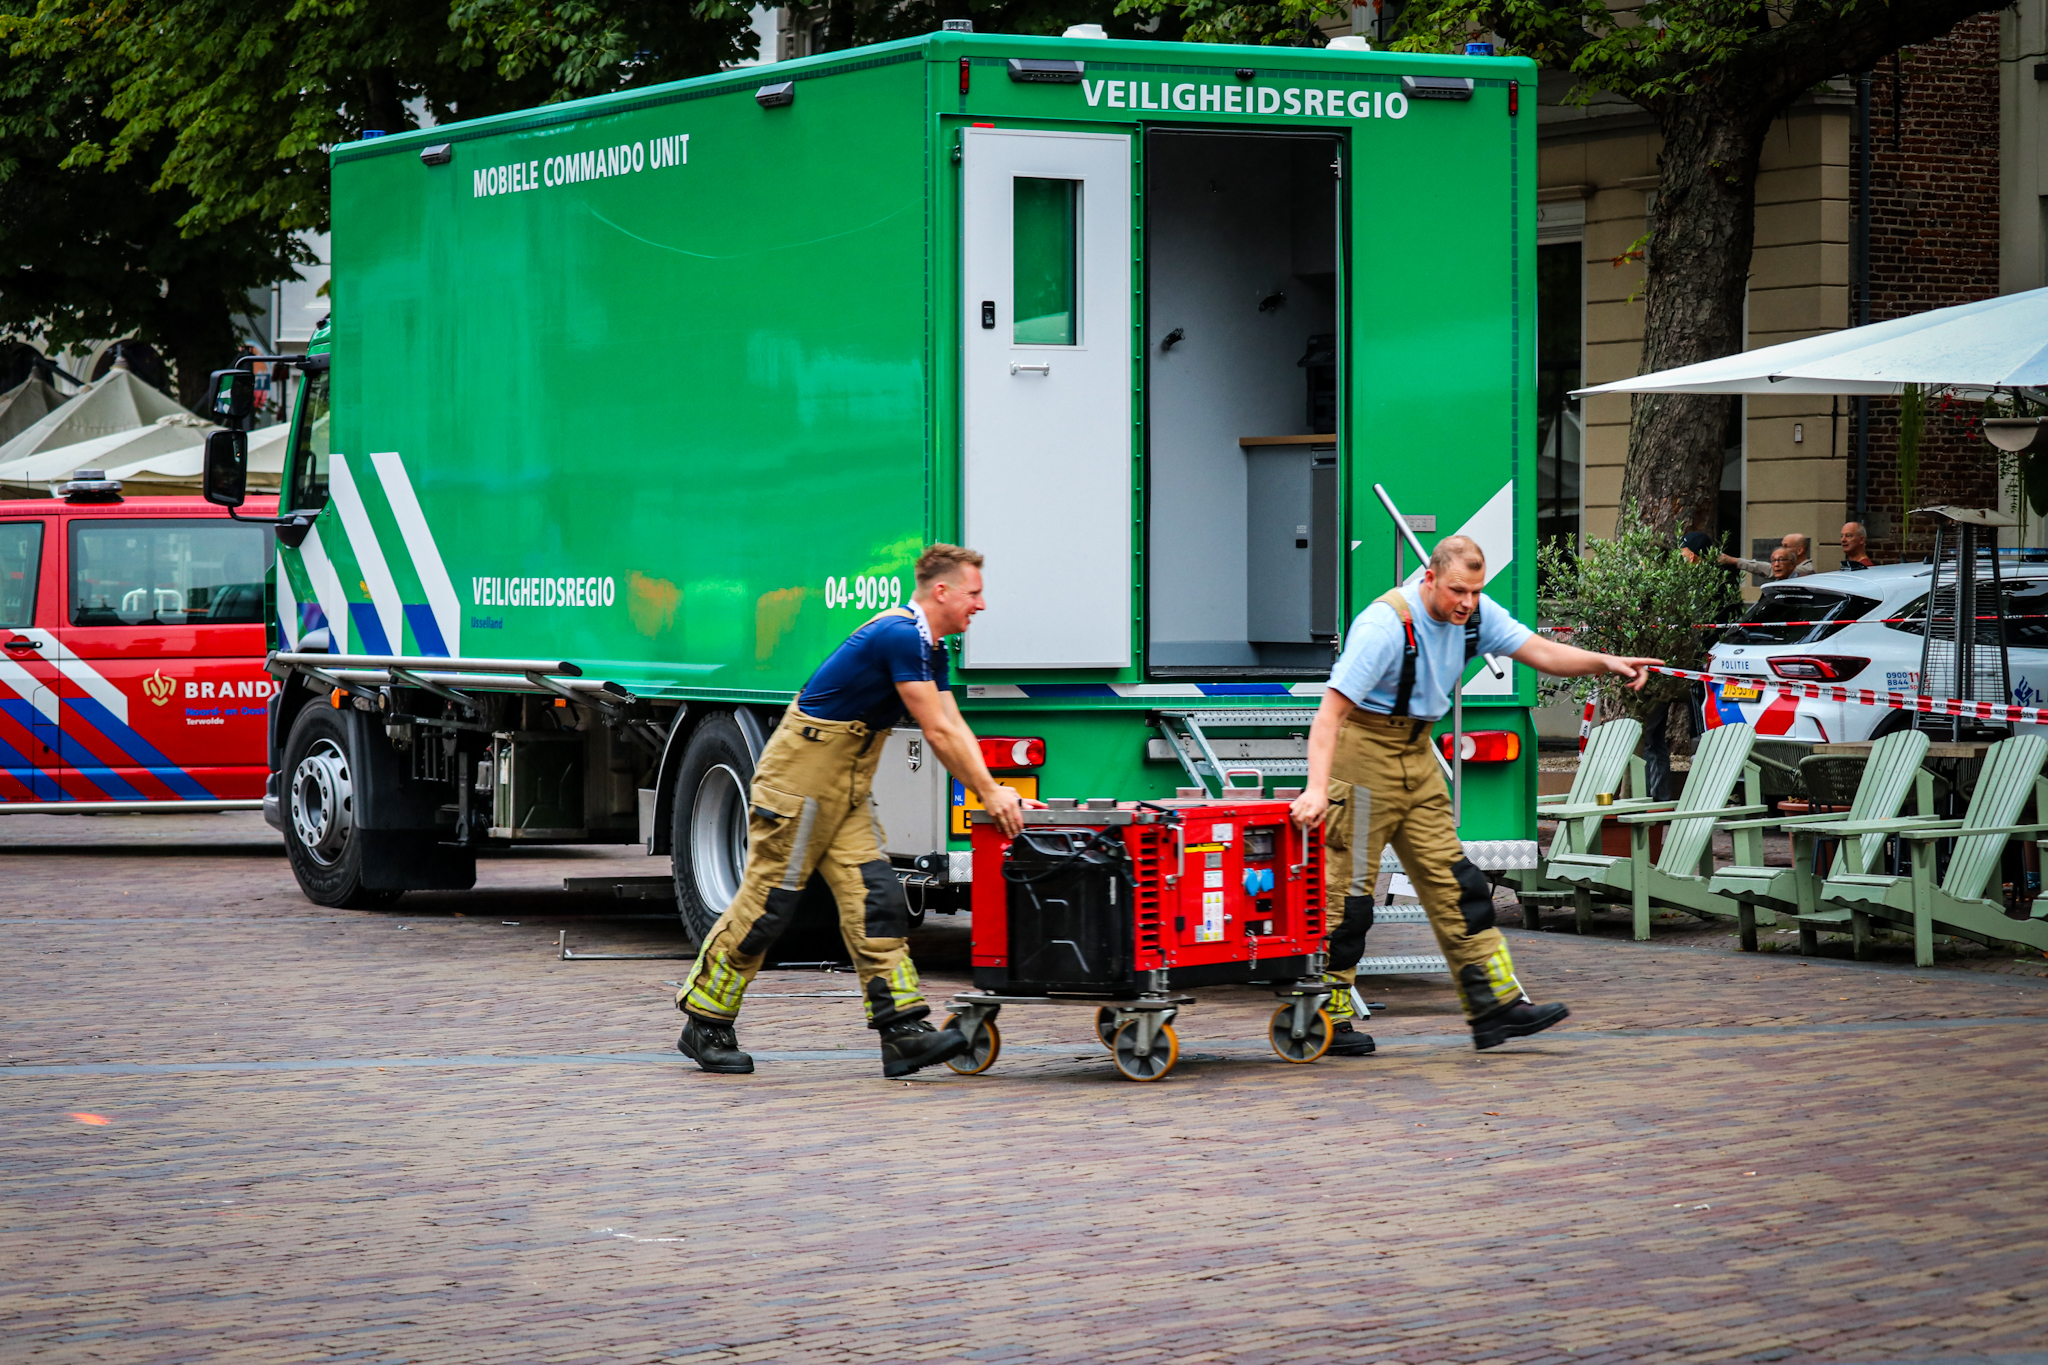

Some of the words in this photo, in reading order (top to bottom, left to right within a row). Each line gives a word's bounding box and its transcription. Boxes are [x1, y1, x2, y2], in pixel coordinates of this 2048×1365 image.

[1081, 79, 1409, 120] VEILIGHEIDSREGIO
[473, 160, 539, 198] MOBIELE
[543, 141, 645, 188] COMMANDO
[650, 133, 690, 169] UNIT
[472, 576, 616, 607] VEILIGHEIDSREGIO
[825, 576, 902, 610] 04-9099
[1721, 660, 1749, 670] POLITIE
[185, 681, 281, 699] BRAND
[185, 706, 222, 716] Noord-
[241, 706, 268, 716] Oost-
[186, 717, 225, 725] Terwolde
